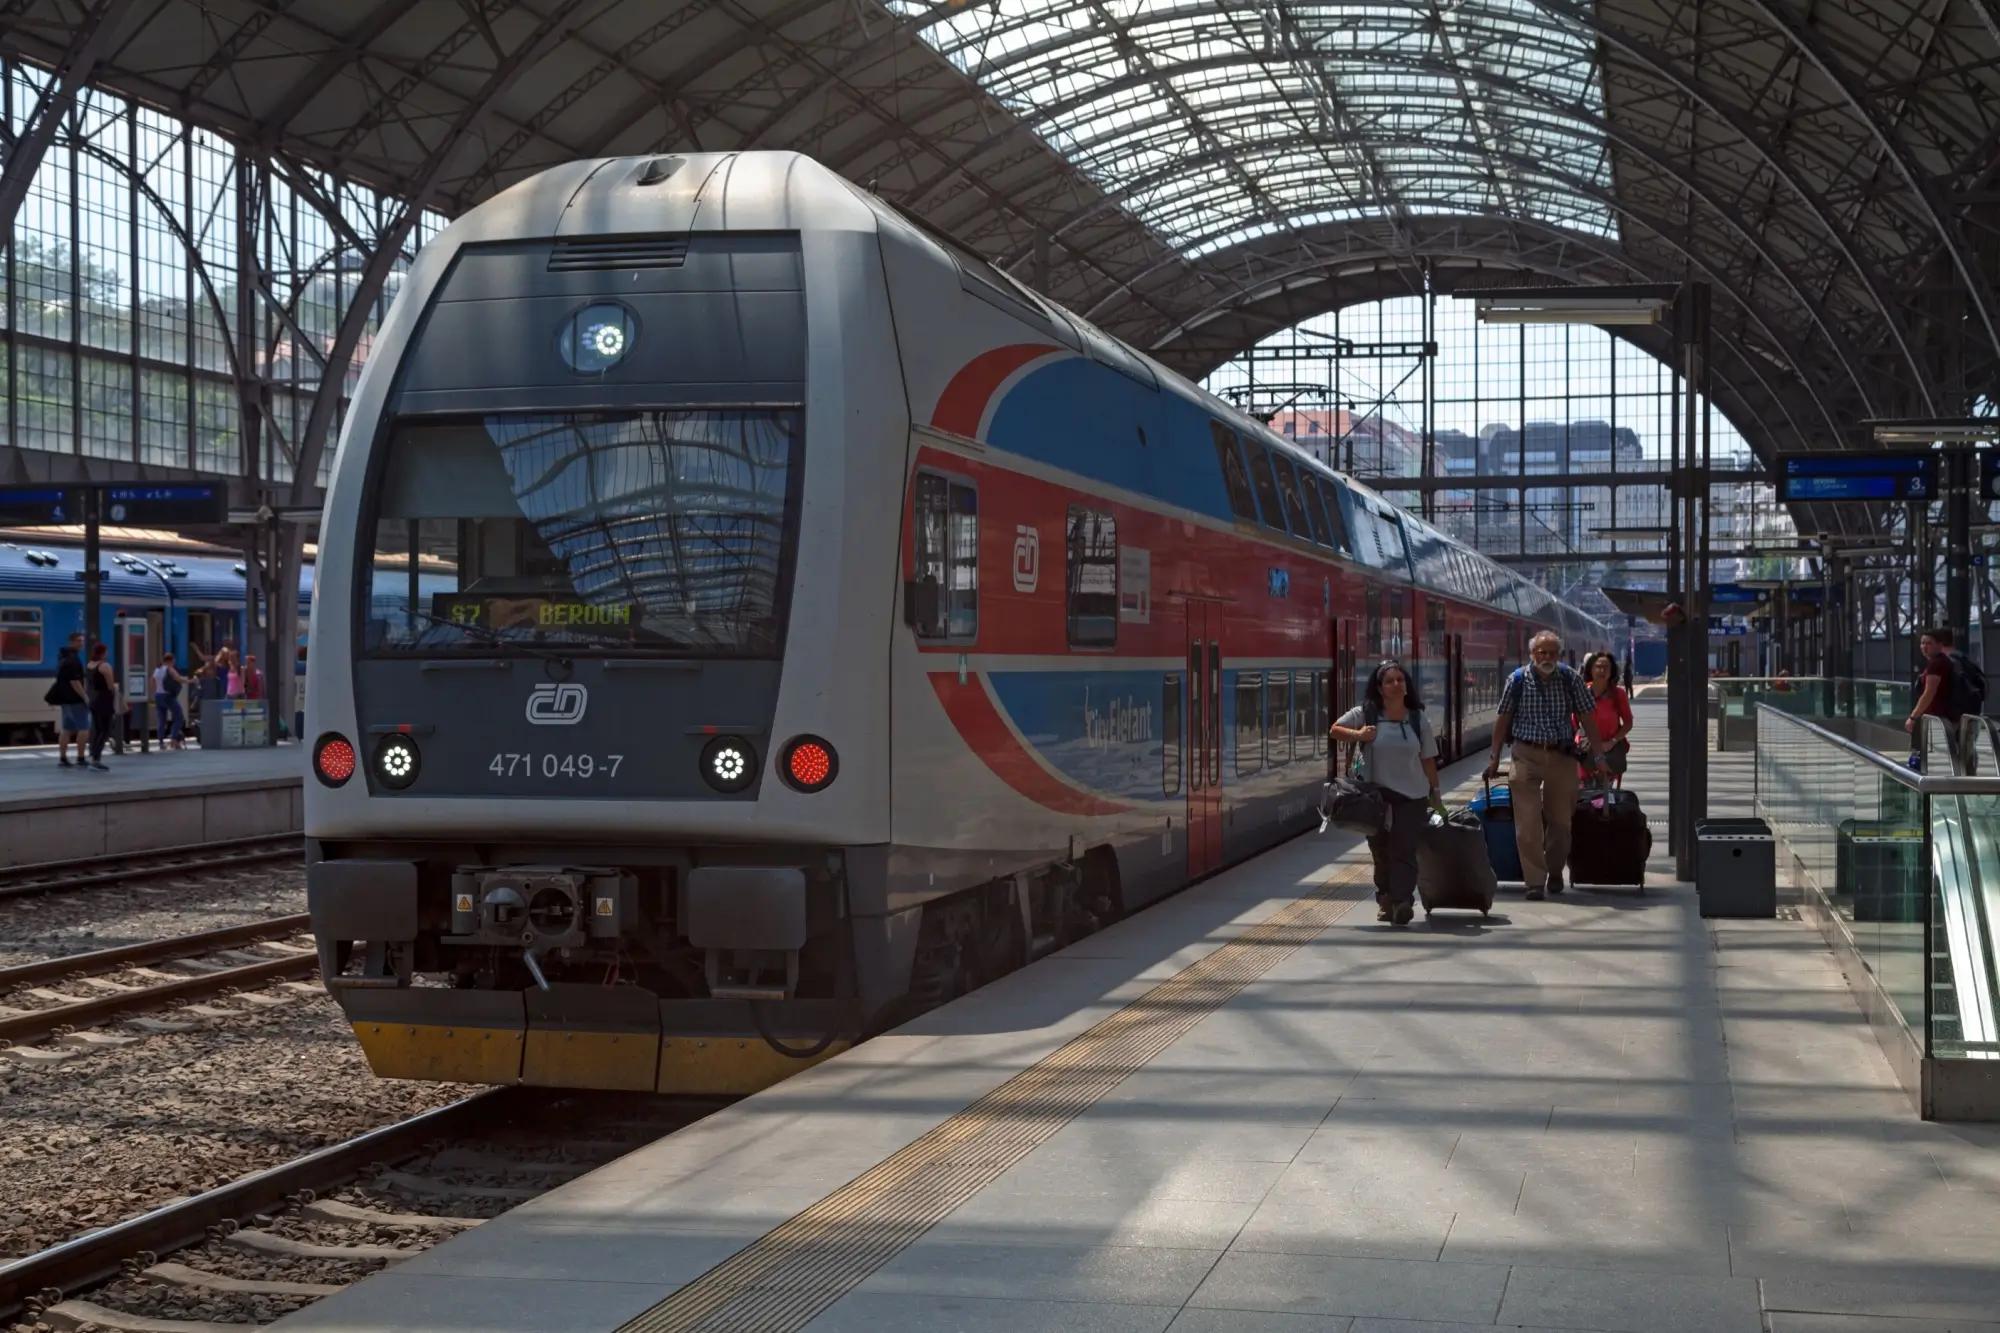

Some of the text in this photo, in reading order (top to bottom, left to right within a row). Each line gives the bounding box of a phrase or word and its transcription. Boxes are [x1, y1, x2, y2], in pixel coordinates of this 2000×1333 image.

[539, 603, 631, 625] BEROUN
[489, 753, 624, 778] 471 049-7
